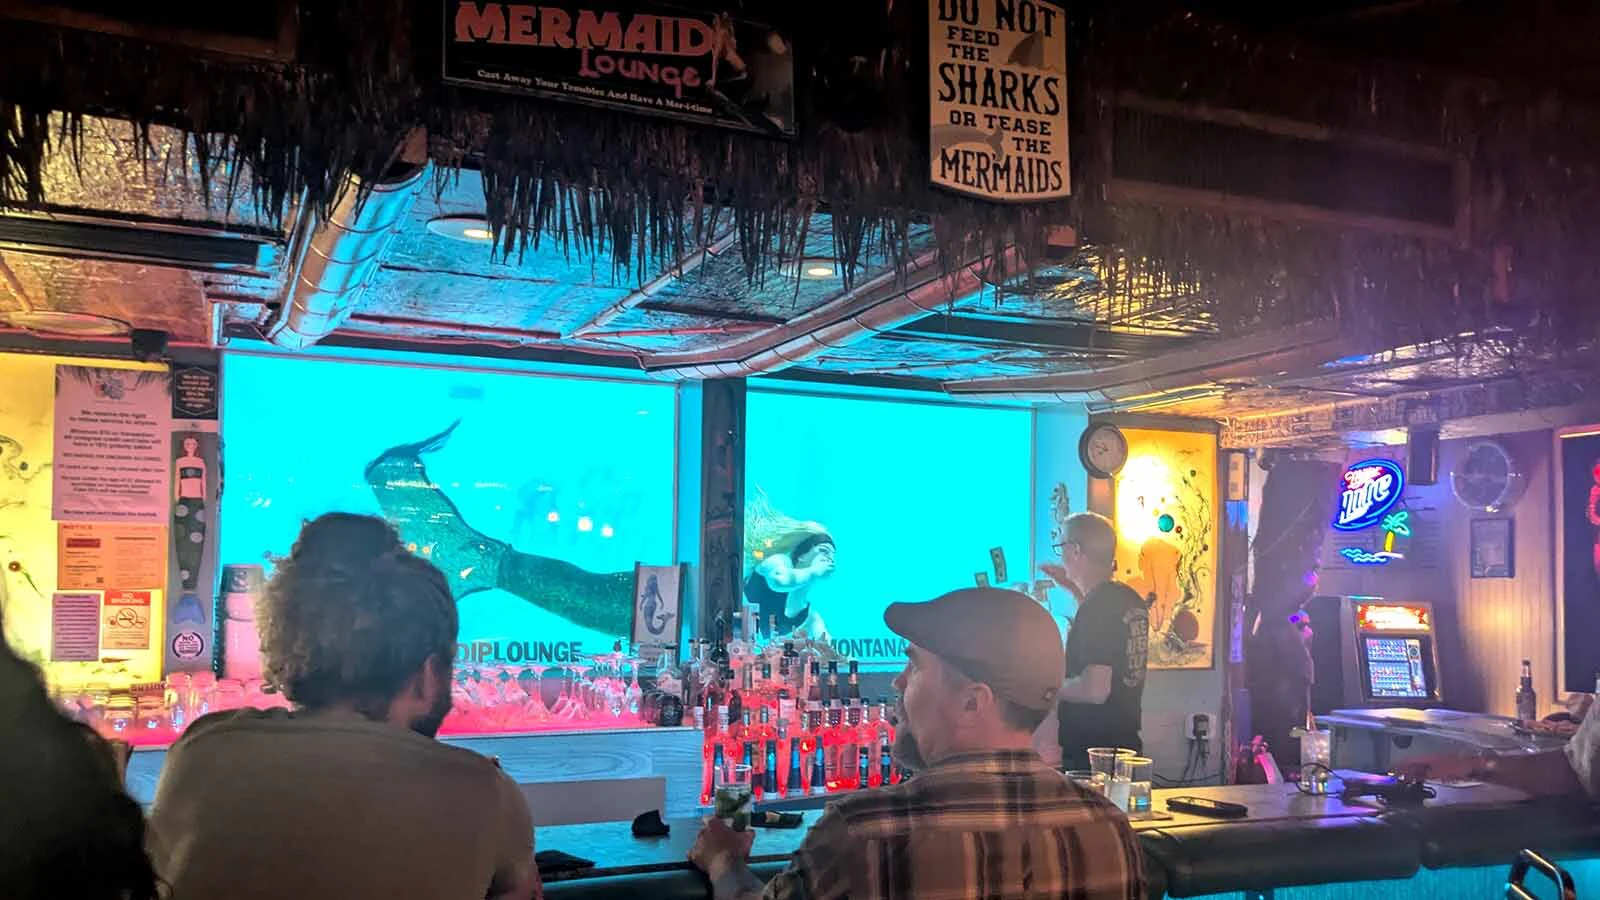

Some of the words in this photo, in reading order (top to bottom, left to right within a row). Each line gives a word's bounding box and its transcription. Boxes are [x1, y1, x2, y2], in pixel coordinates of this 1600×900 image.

[454, 1, 713, 56] MERMAID
[938, 0, 979, 25] DO
[996, 0, 1056, 37] NOT
[947, 25, 1000, 47] FEED
[947, 44, 990, 62] THE
[476, 68, 501, 80] Cast
[504, 73, 532, 86] Away
[535, 77, 562, 89] Your
[561, 81, 605, 97] Troubles
[607, 89, 628, 99] And
[629, 92, 653, 104] Have
[655, 97, 664, 106] A
[938, 62, 1060, 116] SHARKS
[950, 110, 977, 127] OR
[984, 114, 1051, 136] TEASE
[1012, 137, 1051, 154] THE
[940, 147, 1063, 194] MERMAIDS
